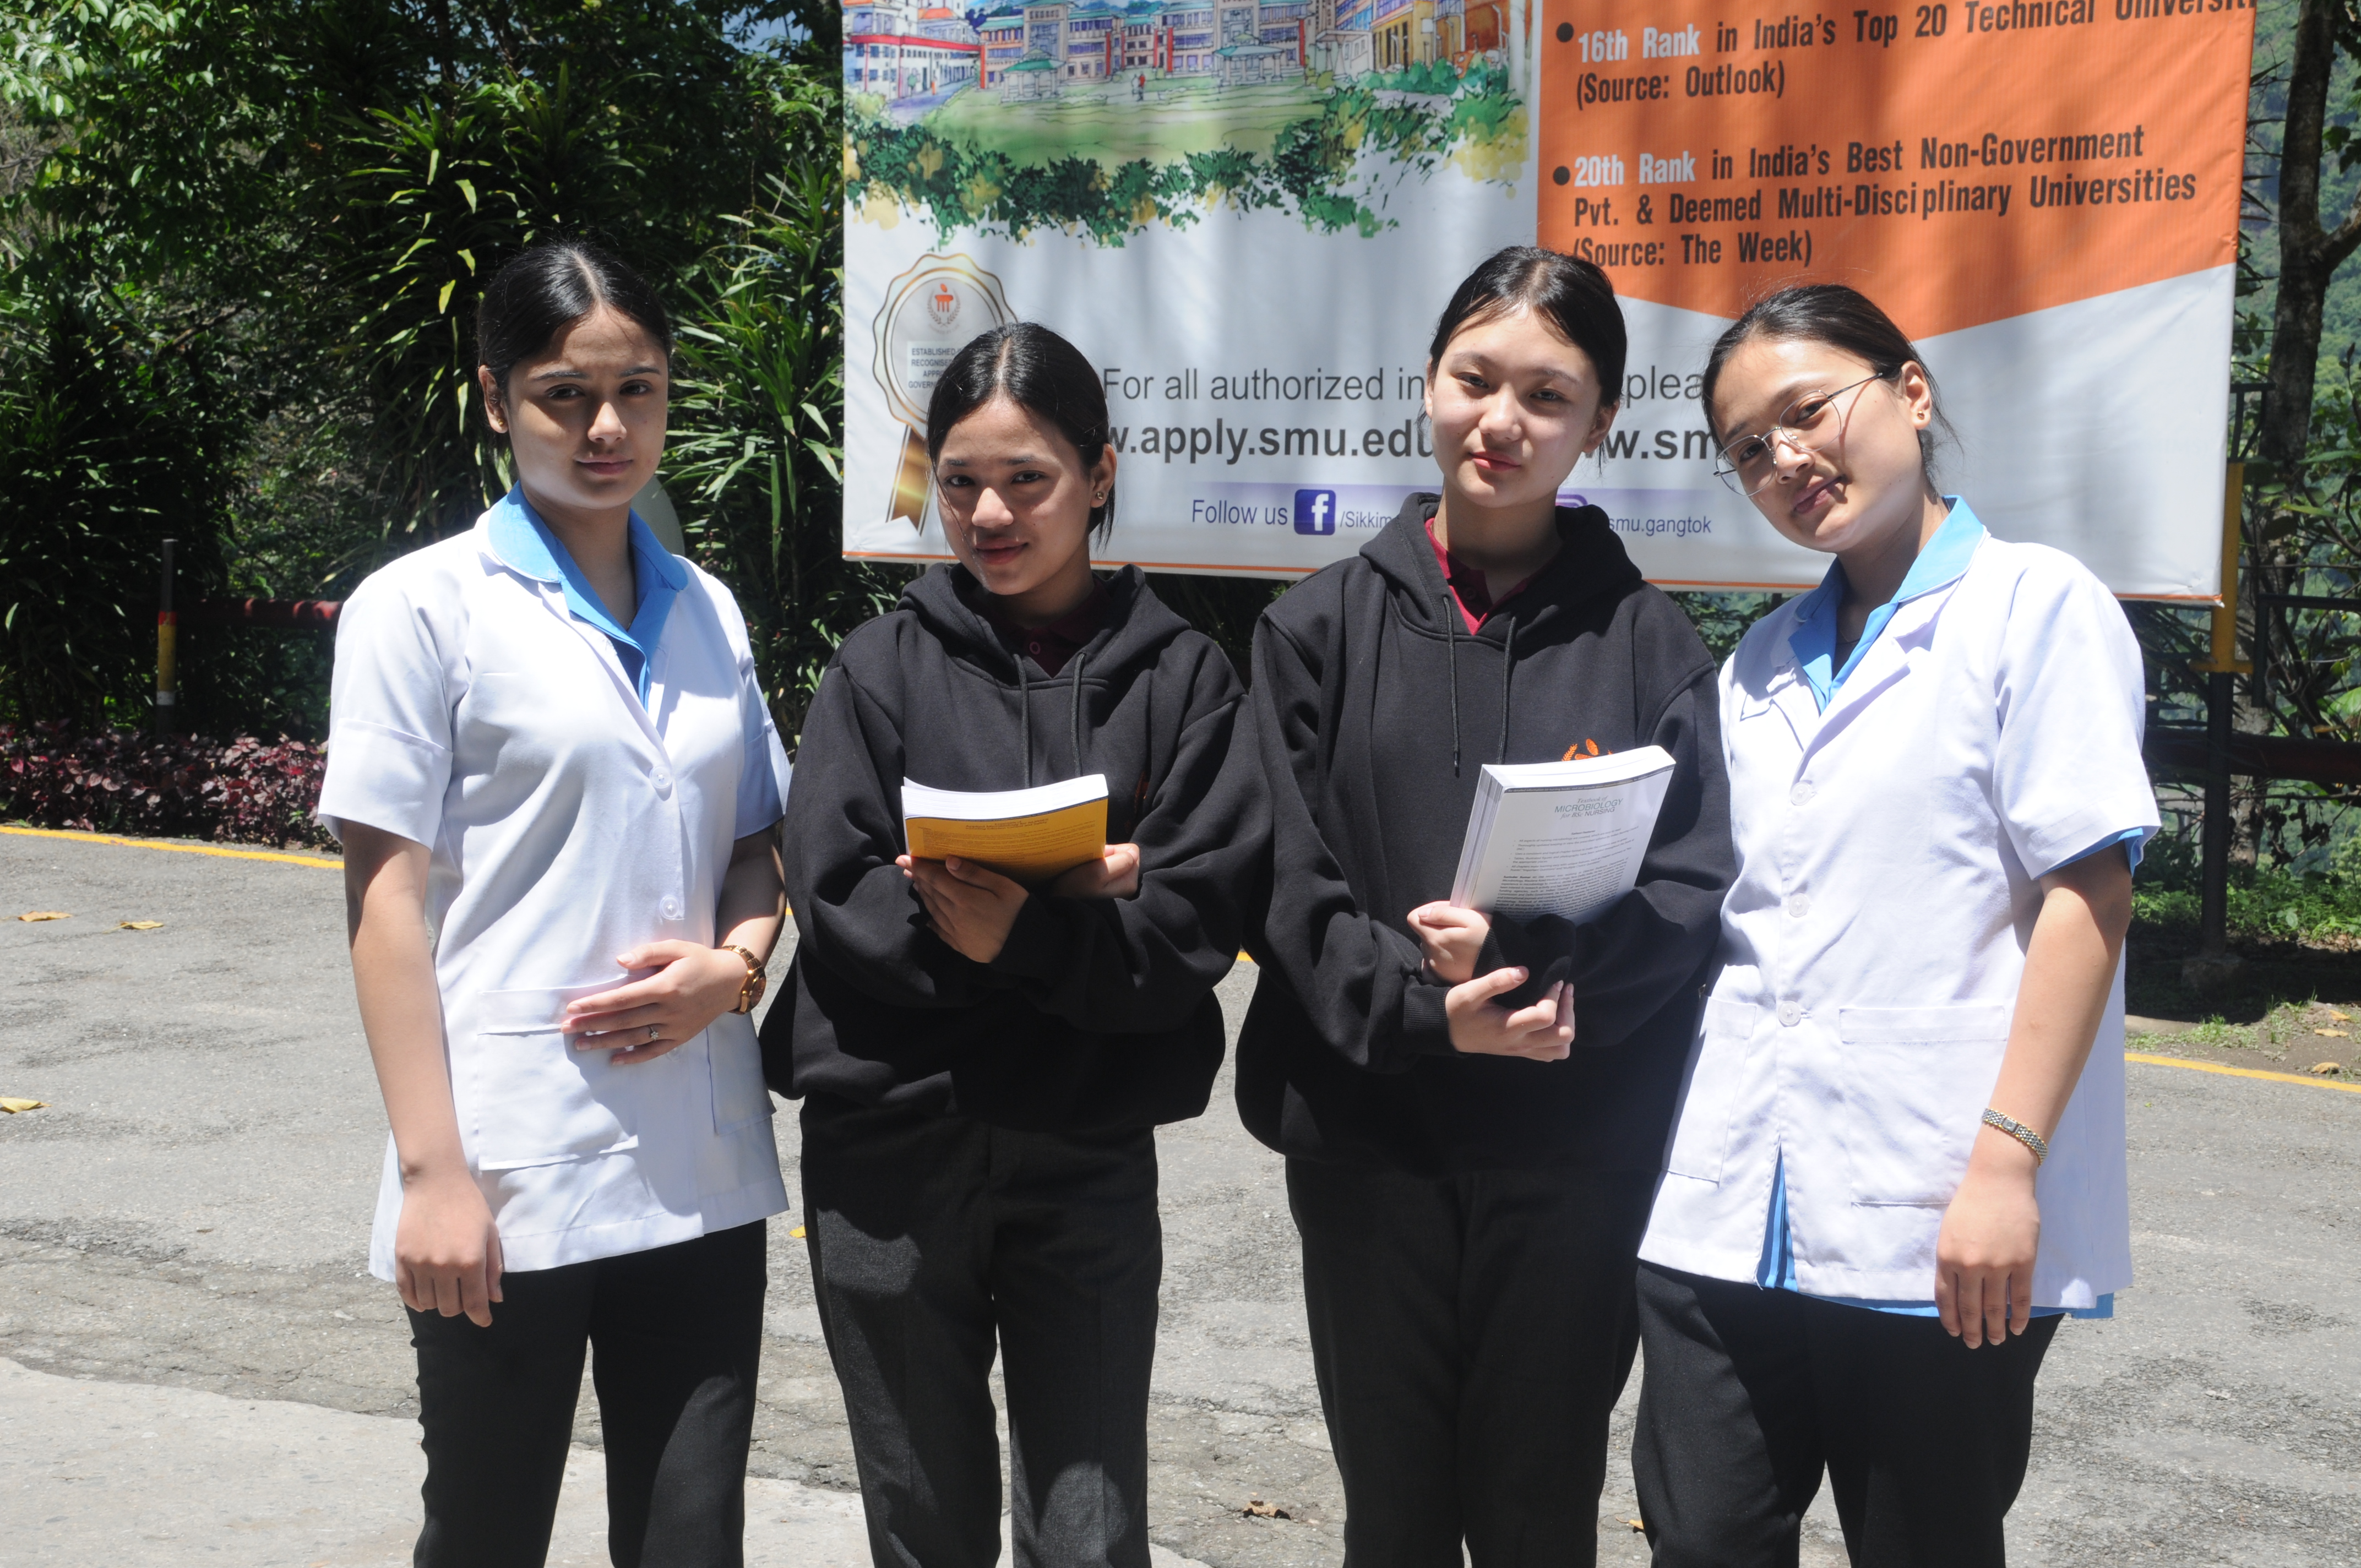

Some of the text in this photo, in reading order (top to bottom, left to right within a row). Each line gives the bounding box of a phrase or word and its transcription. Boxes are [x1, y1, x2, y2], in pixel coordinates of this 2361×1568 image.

[1578, 29, 1628, 63] 16th
[1642, 24, 1701, 58] Rank
[1716, 21, 1738, 53] in
[1754, 14, 1836, 50] India's
[1853, 10, 1898, 48] Top
[1915, 3, 1947, 38] 20
[1965, 0, 2094, 33] Technical
[1577, 60, 1786, 111] (Source: Outlook)
[1574, 125, 2145, 187] 20th Rank in India's Best Non-Government
[1574, 198, 1619, 227] Pvt.
[1636, 194, 1653, 225] &
[1669, 189, 1761, 224] Deemed
[2030, 168, 2196, 208] Universities
[1680, 234, 1722, 264] The
[1738, 230, 1812, 267] Week)
[911, 347, 956, 356] ESTABLISHED
[1104, 368, 1155, 400] For
[1165, 368, 1198, 400] all
[1211, 367, 1384, 401] authorized
[1585, 429, 1717, 459] w.sm
[1192, 499, 1258, 525] Follow
[1265, 507, 1288, 526] us
[1554, 798, 1624, 813] MICROBIOLOGY
[1584, 807, 1615, 816] NURSING
